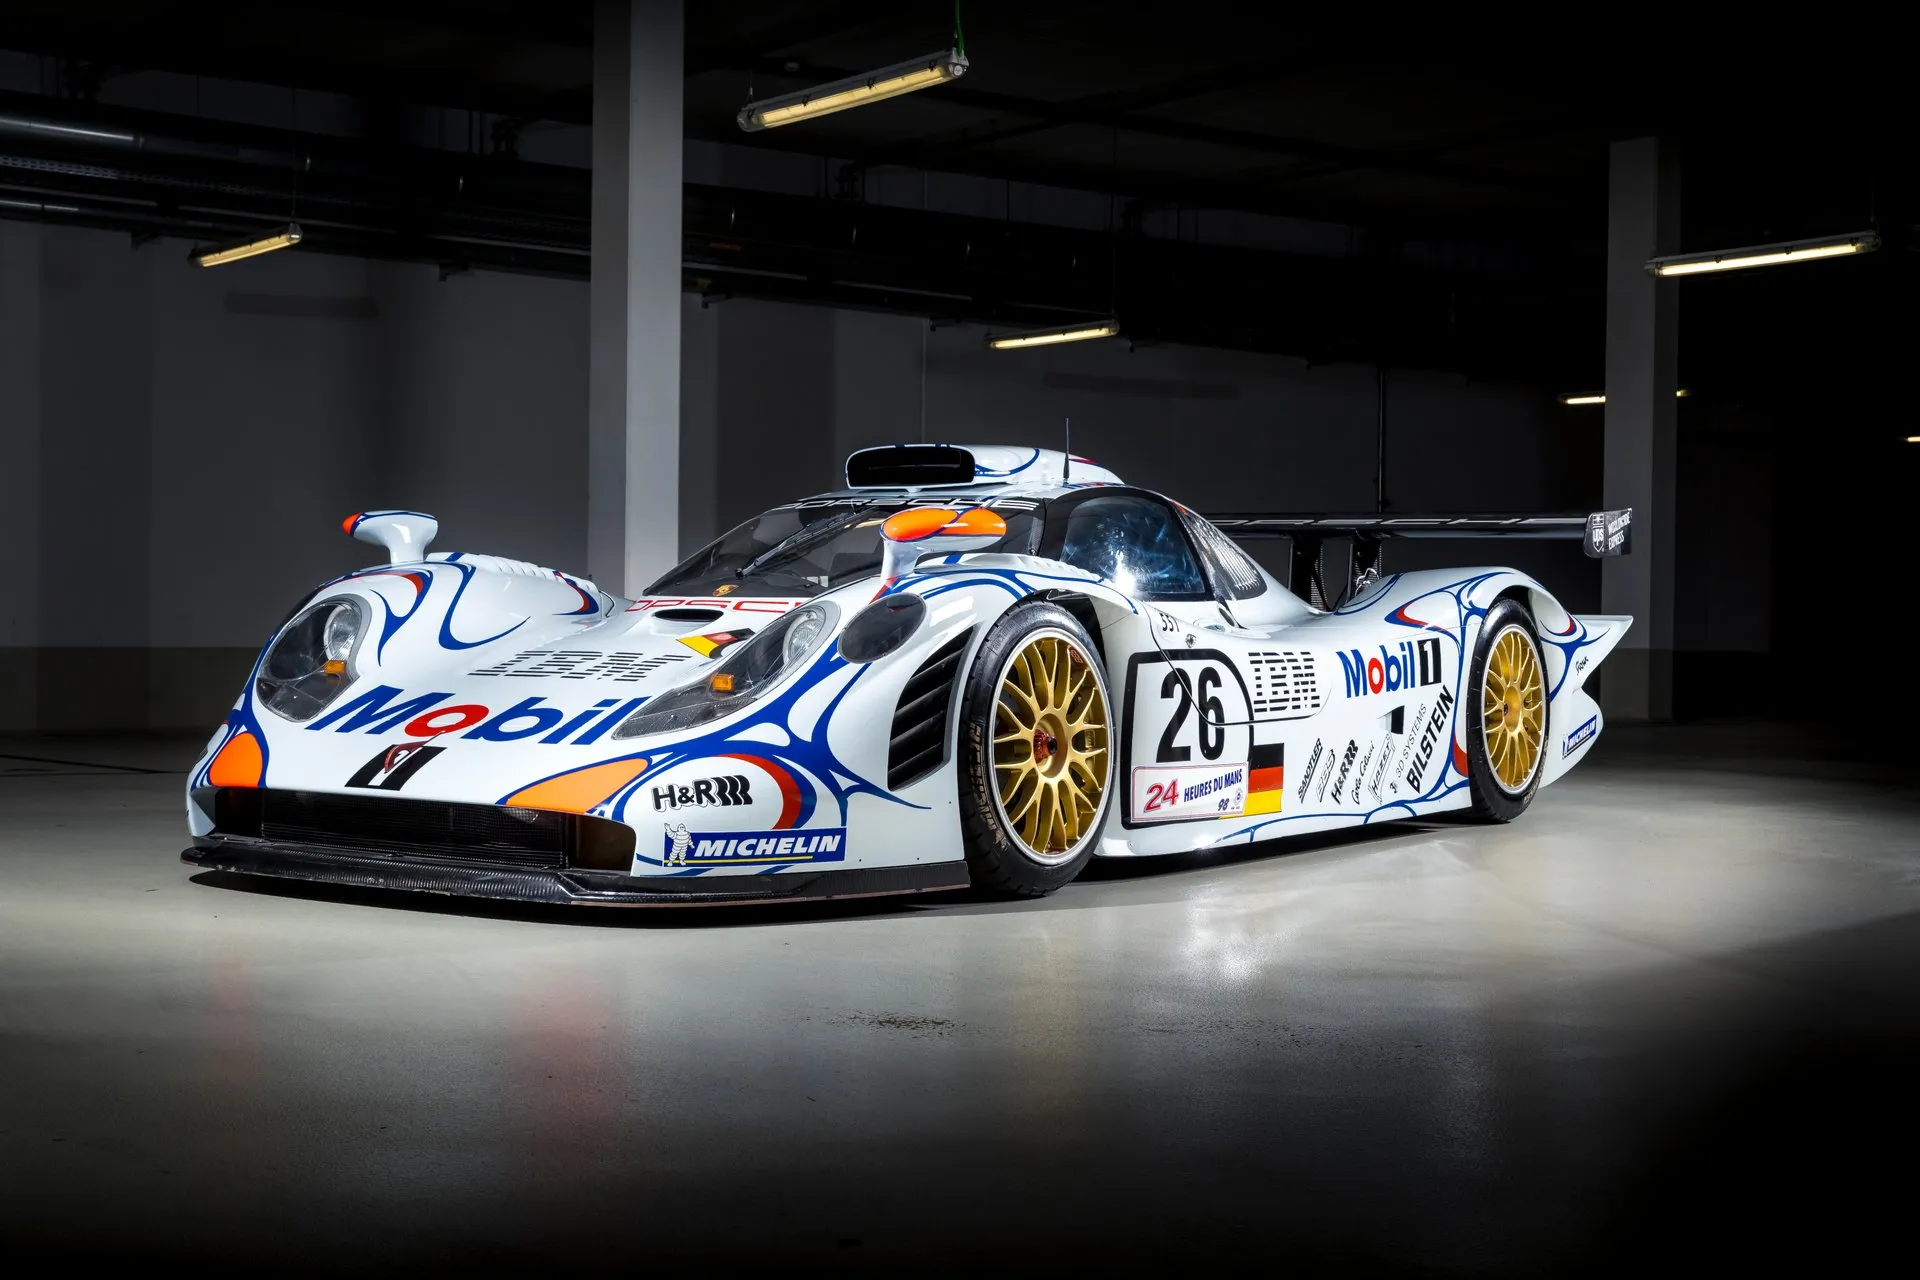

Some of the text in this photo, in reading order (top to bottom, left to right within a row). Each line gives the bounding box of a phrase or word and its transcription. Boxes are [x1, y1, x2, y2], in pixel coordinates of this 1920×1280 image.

[766, 498, 1039, 512] PORSCHE
[1609, 530, 1624, 550] EXPRESS
[467, 650, 692, 682] IBM
[1248, 651, 1320, 712] IBM
[1336, 639, 1438, 698] Mobil 1
[304, 684, 652, 745] Mobil
[1156, 667, 1225, 763] 26
[1568, 719, 1596, 749] MICHELIN
[1395, 703, 1427, 778] 3D SYSTEMS
[1406, 684, 1454, 794] BILSTEIN
[1144, 768, 1242, 813] 24 HEURES DU MANS
[1298, 738, 1321, 800] SANDTLER
[652, 776, 735, 812] H&R
[1217, 798, 1229, 811] 98
[694, 834, 841, 857] MICHELIN
